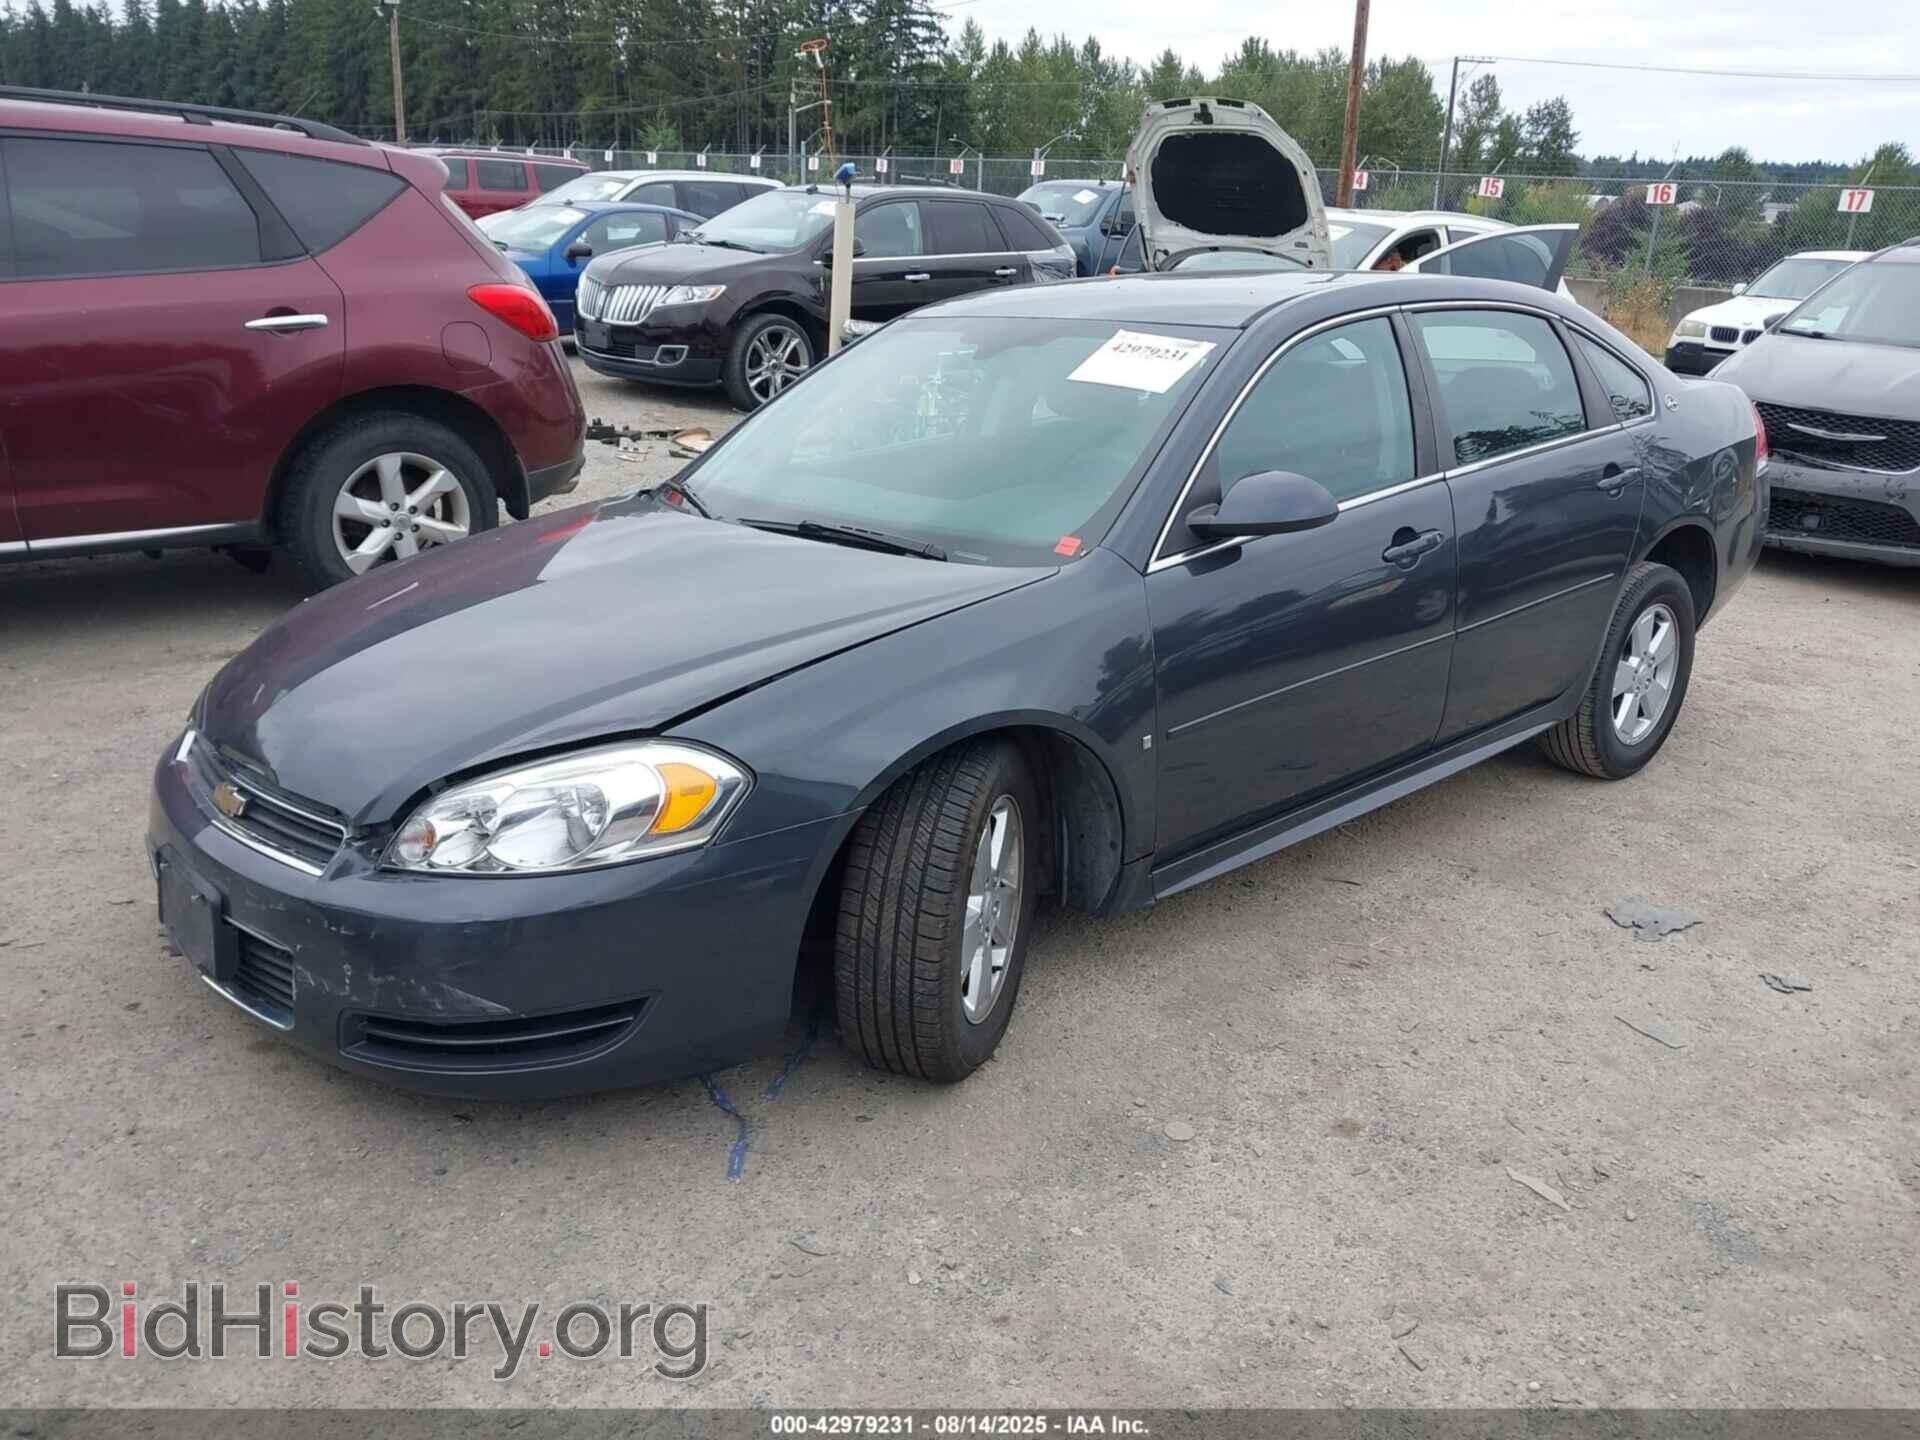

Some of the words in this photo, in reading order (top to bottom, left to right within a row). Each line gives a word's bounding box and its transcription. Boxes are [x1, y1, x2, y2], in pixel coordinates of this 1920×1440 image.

[1484, 179, 1500, 196] 15
[1653, 185, 1671, 202] 16
[1847, 191, 1868, 210] 17
